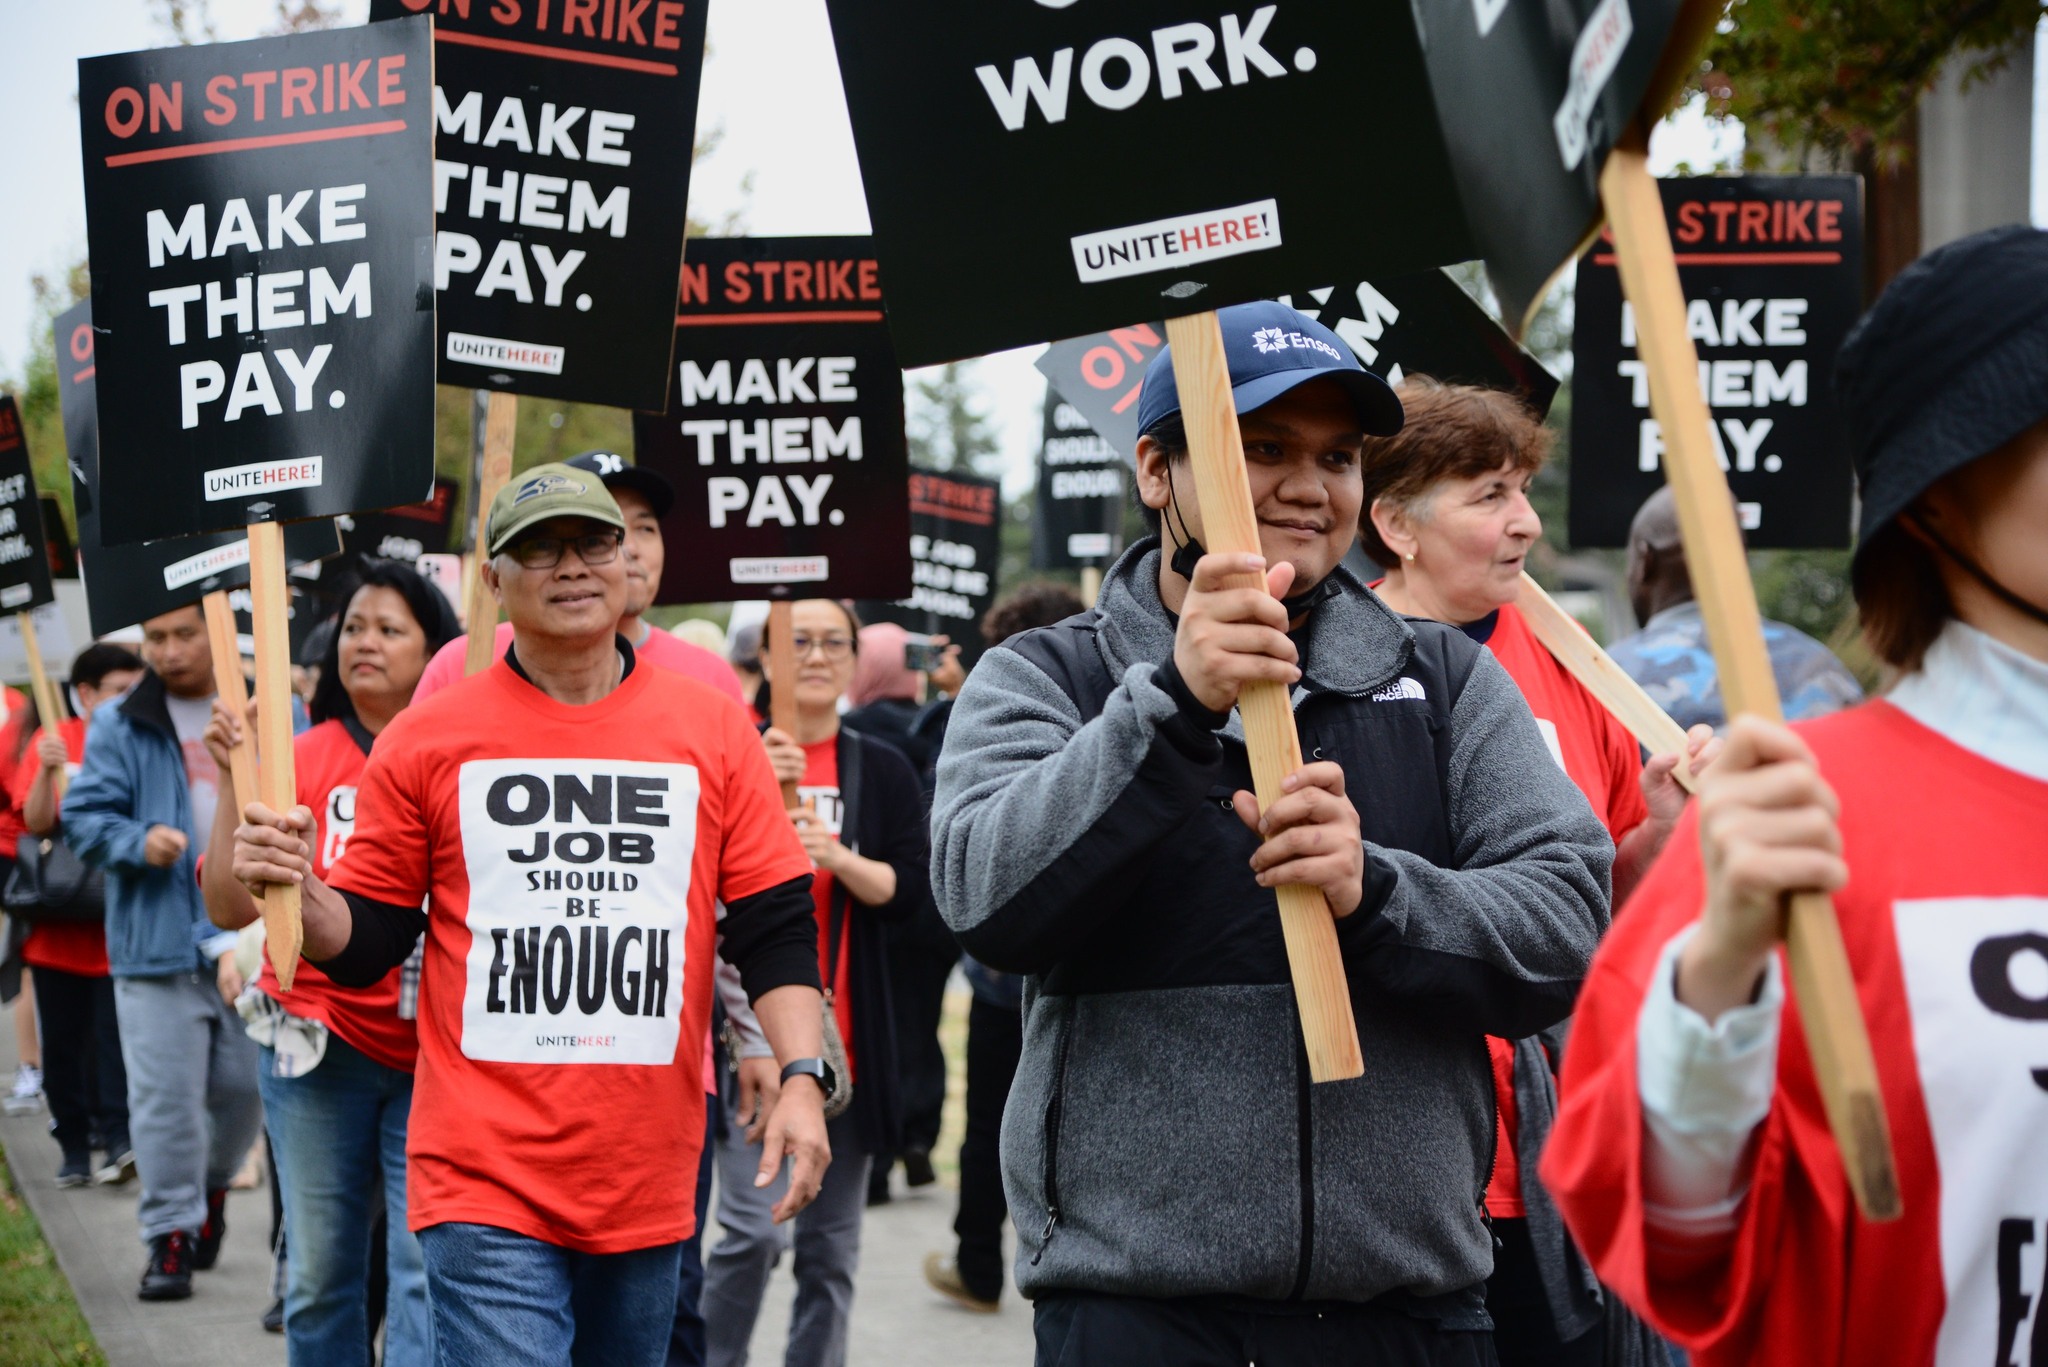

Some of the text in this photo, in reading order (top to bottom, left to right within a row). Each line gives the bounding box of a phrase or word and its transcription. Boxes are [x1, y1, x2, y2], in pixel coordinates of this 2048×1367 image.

[975, 4, 1317, 131] WORK.
[104, 54, 406, 139] ON STRIKE
[435, 85, 635, 167] MAKE
[435, 159, 630, 238] THEM
[1676, 200, 1843, 243] STRIKE
[146, 183, 367, 268] MAKE
[1084, 212, 1272, 270] UNITEHERE!
[435, 230, 593, 312] PAY.
[680, 259, 882, 305] N STRIKE
[148, 261, 372, 345] THEM
[70, 324, 94, 363] O
[452, 338, 558, 366] UNITEHERE!
[1080, 323, 1161, 390] ON
[1289, 332, 1341, 361] Enseo
[180, 343, 346, 430] PAY.
[679, 356, 858, 407] MAKE
[680, 416, 863, 466] THEM
[210, 464, 316, 492] UNITEHERE!
[707, 474, 845, 529] PAY.
[1372, 691, 1403, 702] FACE
[486, 773, 670, 827] ONE
[506, 831, 655, 864] JOB
[526, 870, 638, 892] SHOULD
[566, 897, 600, 918] BE
[486, 925, 670, 1018] ENOUGH
[536, 1034, 615, 1047] UNITEHERE!
